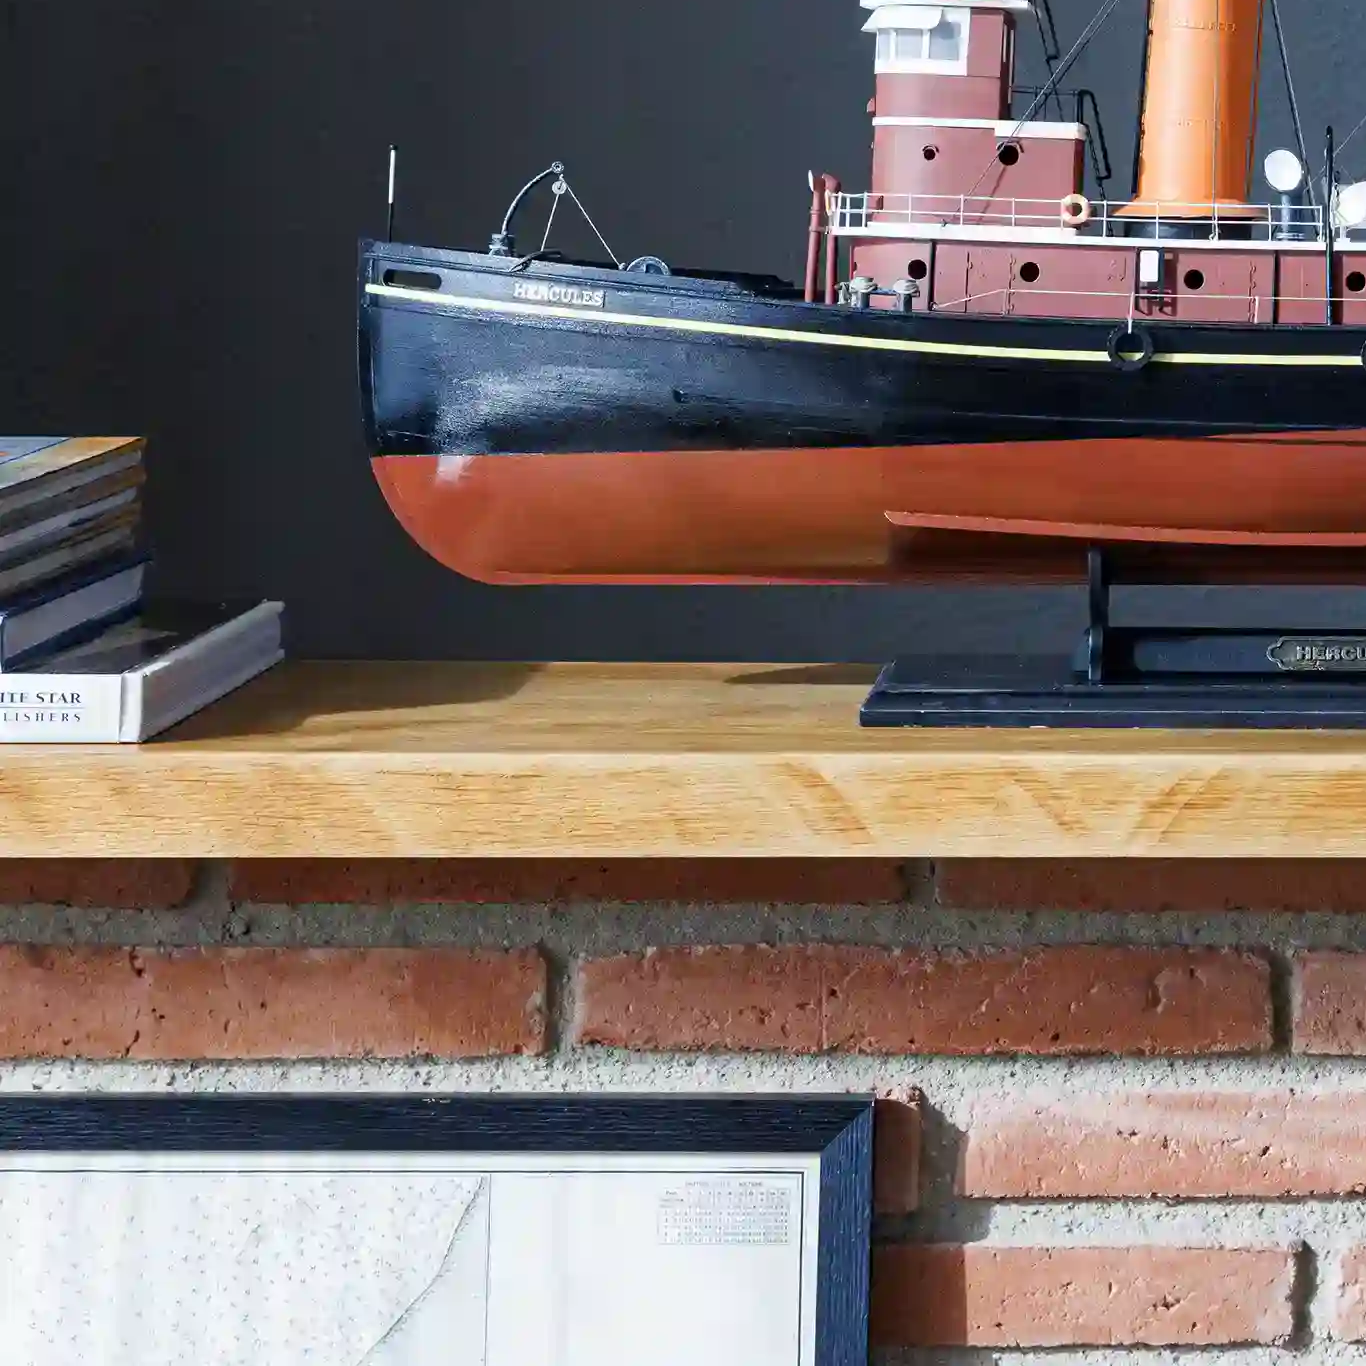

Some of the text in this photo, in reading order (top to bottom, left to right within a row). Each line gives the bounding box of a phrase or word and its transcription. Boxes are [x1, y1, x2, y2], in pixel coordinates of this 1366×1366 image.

[513, 282, 604, 307] HERCULES
[36, 692, 82, 704] STAR
[3, 712, 81, 722] LISHERS
